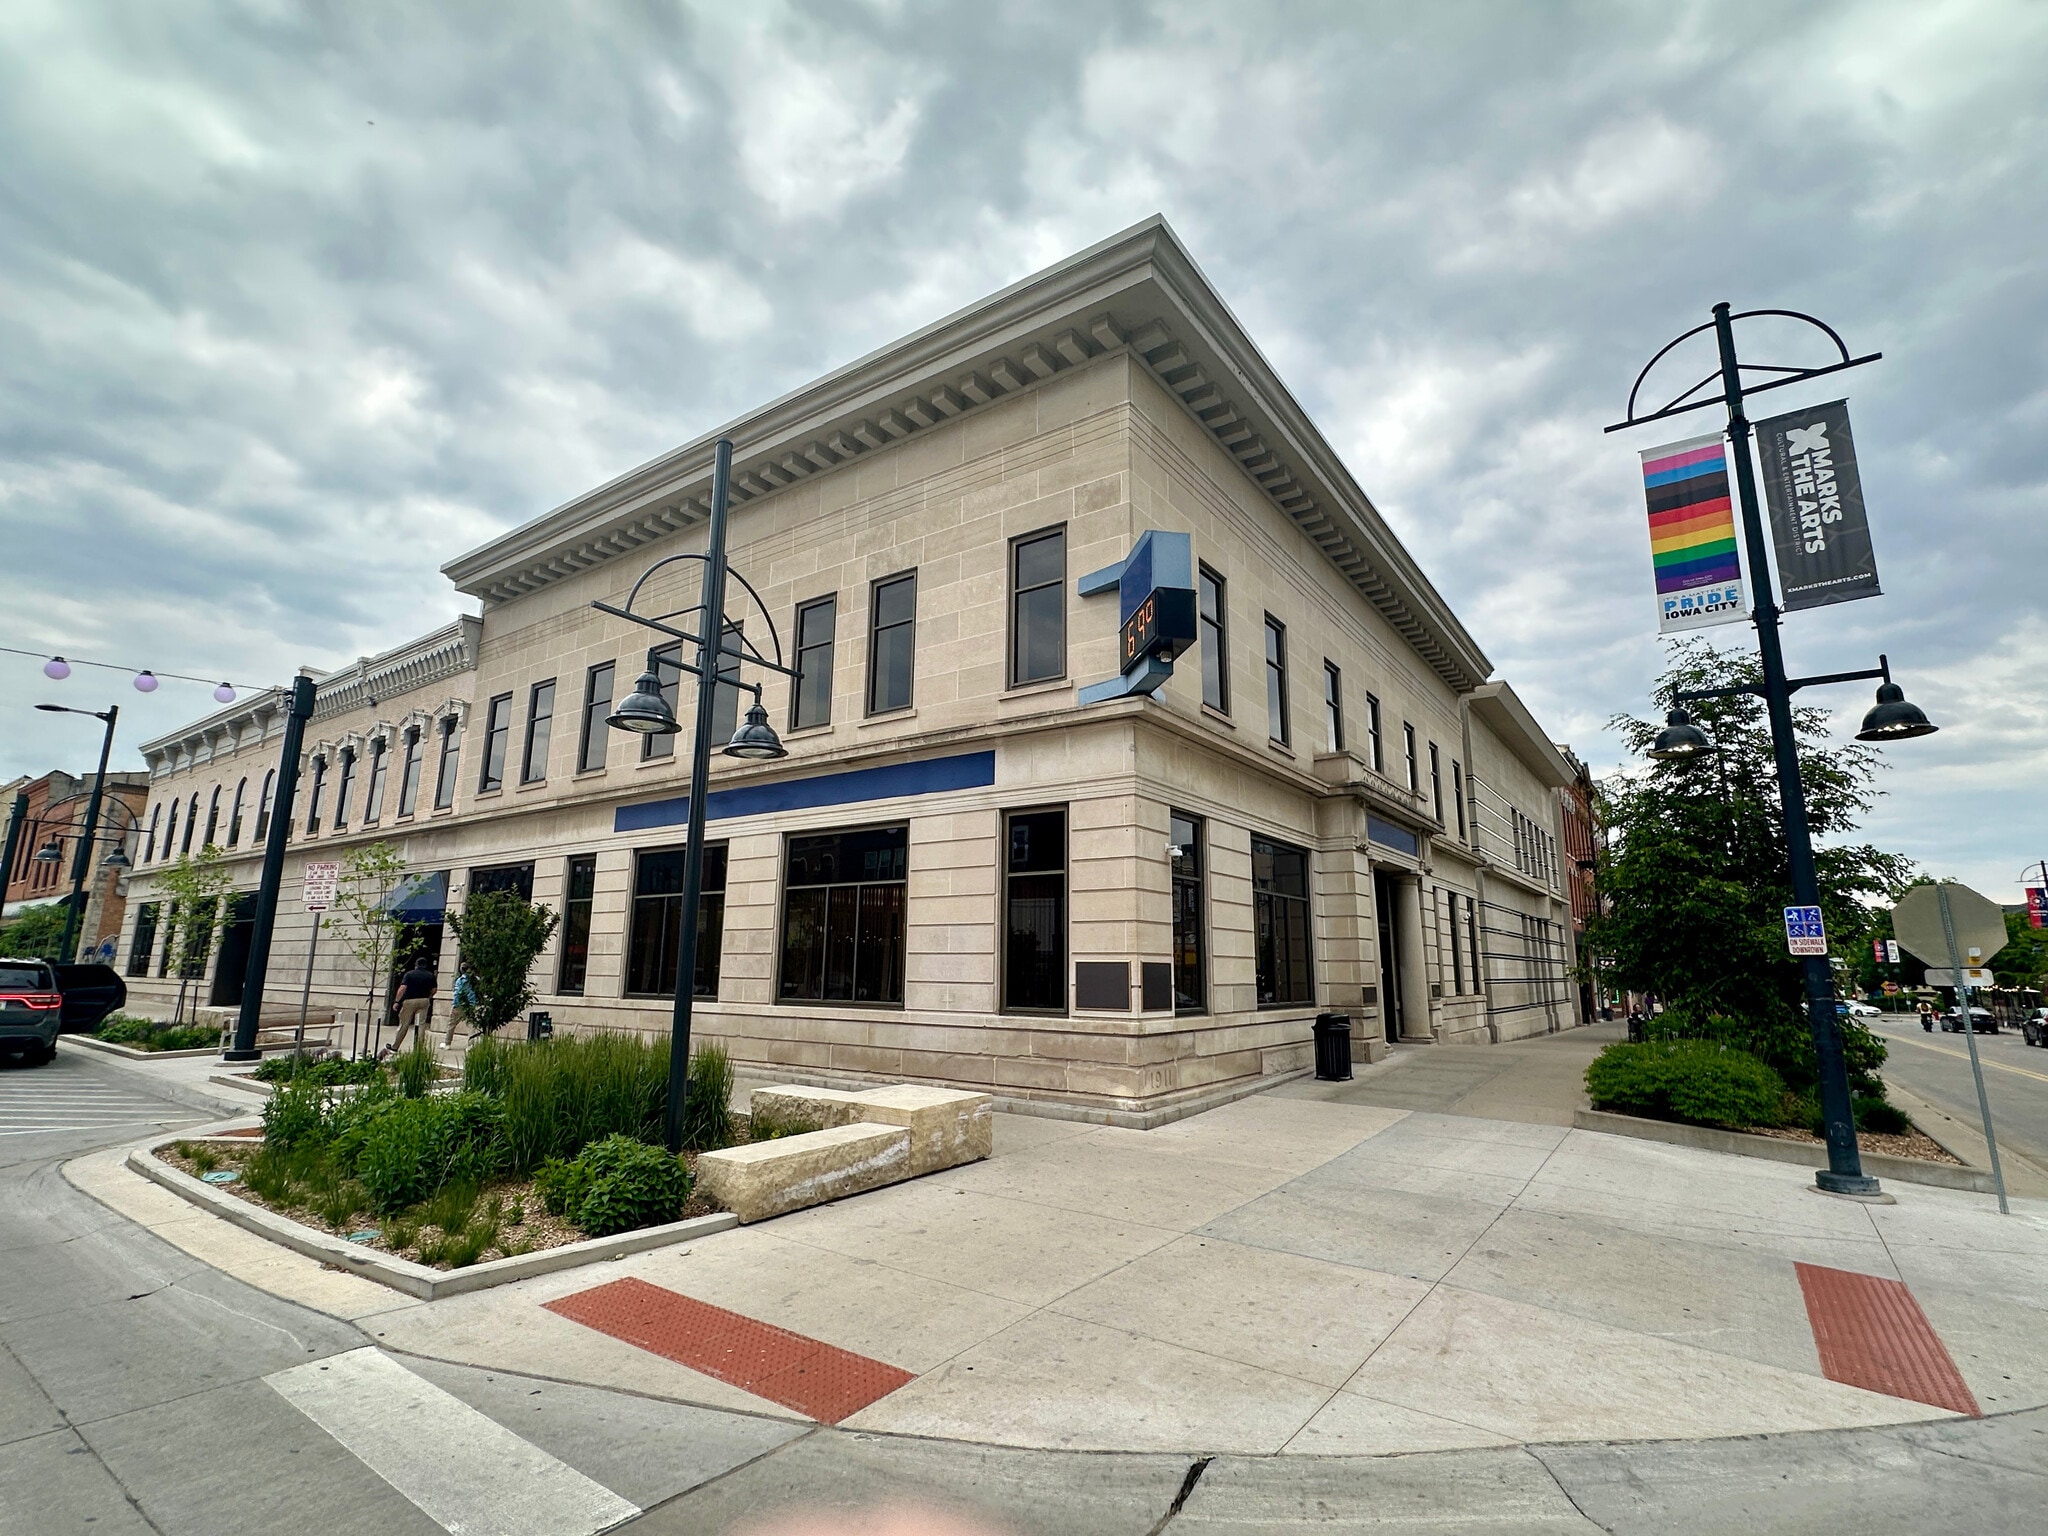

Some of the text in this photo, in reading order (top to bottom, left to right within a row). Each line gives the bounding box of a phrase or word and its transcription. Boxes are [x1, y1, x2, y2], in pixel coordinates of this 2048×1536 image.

[1785, 421, 1843, 525] X MARKS
[1776, 432, 1788, 466] CULTURAL
[1782, 471, 1798, 525] ENTERTAINMENT
[1791, 526, 1803, 556] DISTRICT
[1791, 453, 1826, 554] THE ARTS
[1688, 588, 1722, 597] MATTER
[1786, 572, 1872, 594] XMARKSTHEARTS.COM
[1664, 588, 1738, 612] PRIDE
[1665, 600, 1738, 620] IOWA CITY
[1790, 938, 1824, 946] ON SIDEWALK
[1150, 1069, 1172, 1089] 1911
